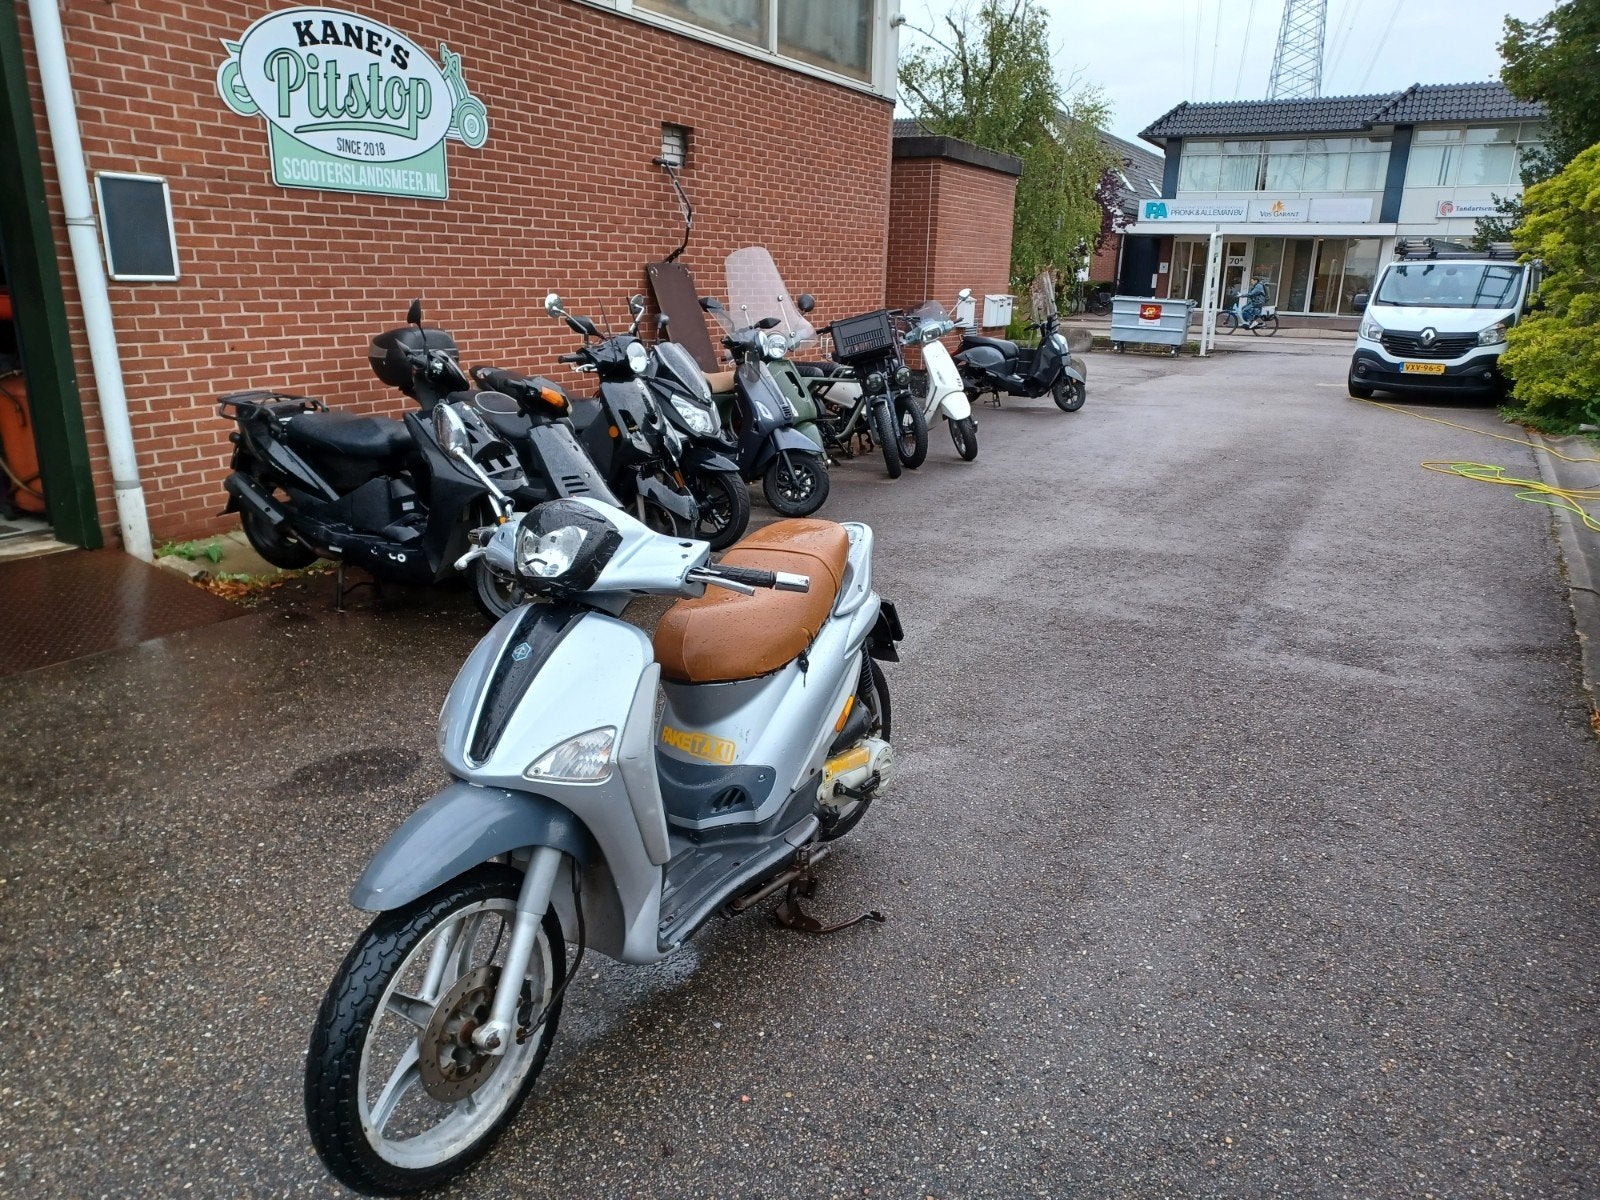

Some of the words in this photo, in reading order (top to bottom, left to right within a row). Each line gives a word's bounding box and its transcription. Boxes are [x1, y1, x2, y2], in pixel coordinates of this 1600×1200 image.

[292, 19, 410, 70] KANE'S
[263, 47, 432, 140] Pitstop
[336, 137, 361, 156] SINCE
[363, 141, 386, 156] 2018
[281, 156, 442, 193] SCOOTERSLANDSMEER.NL
